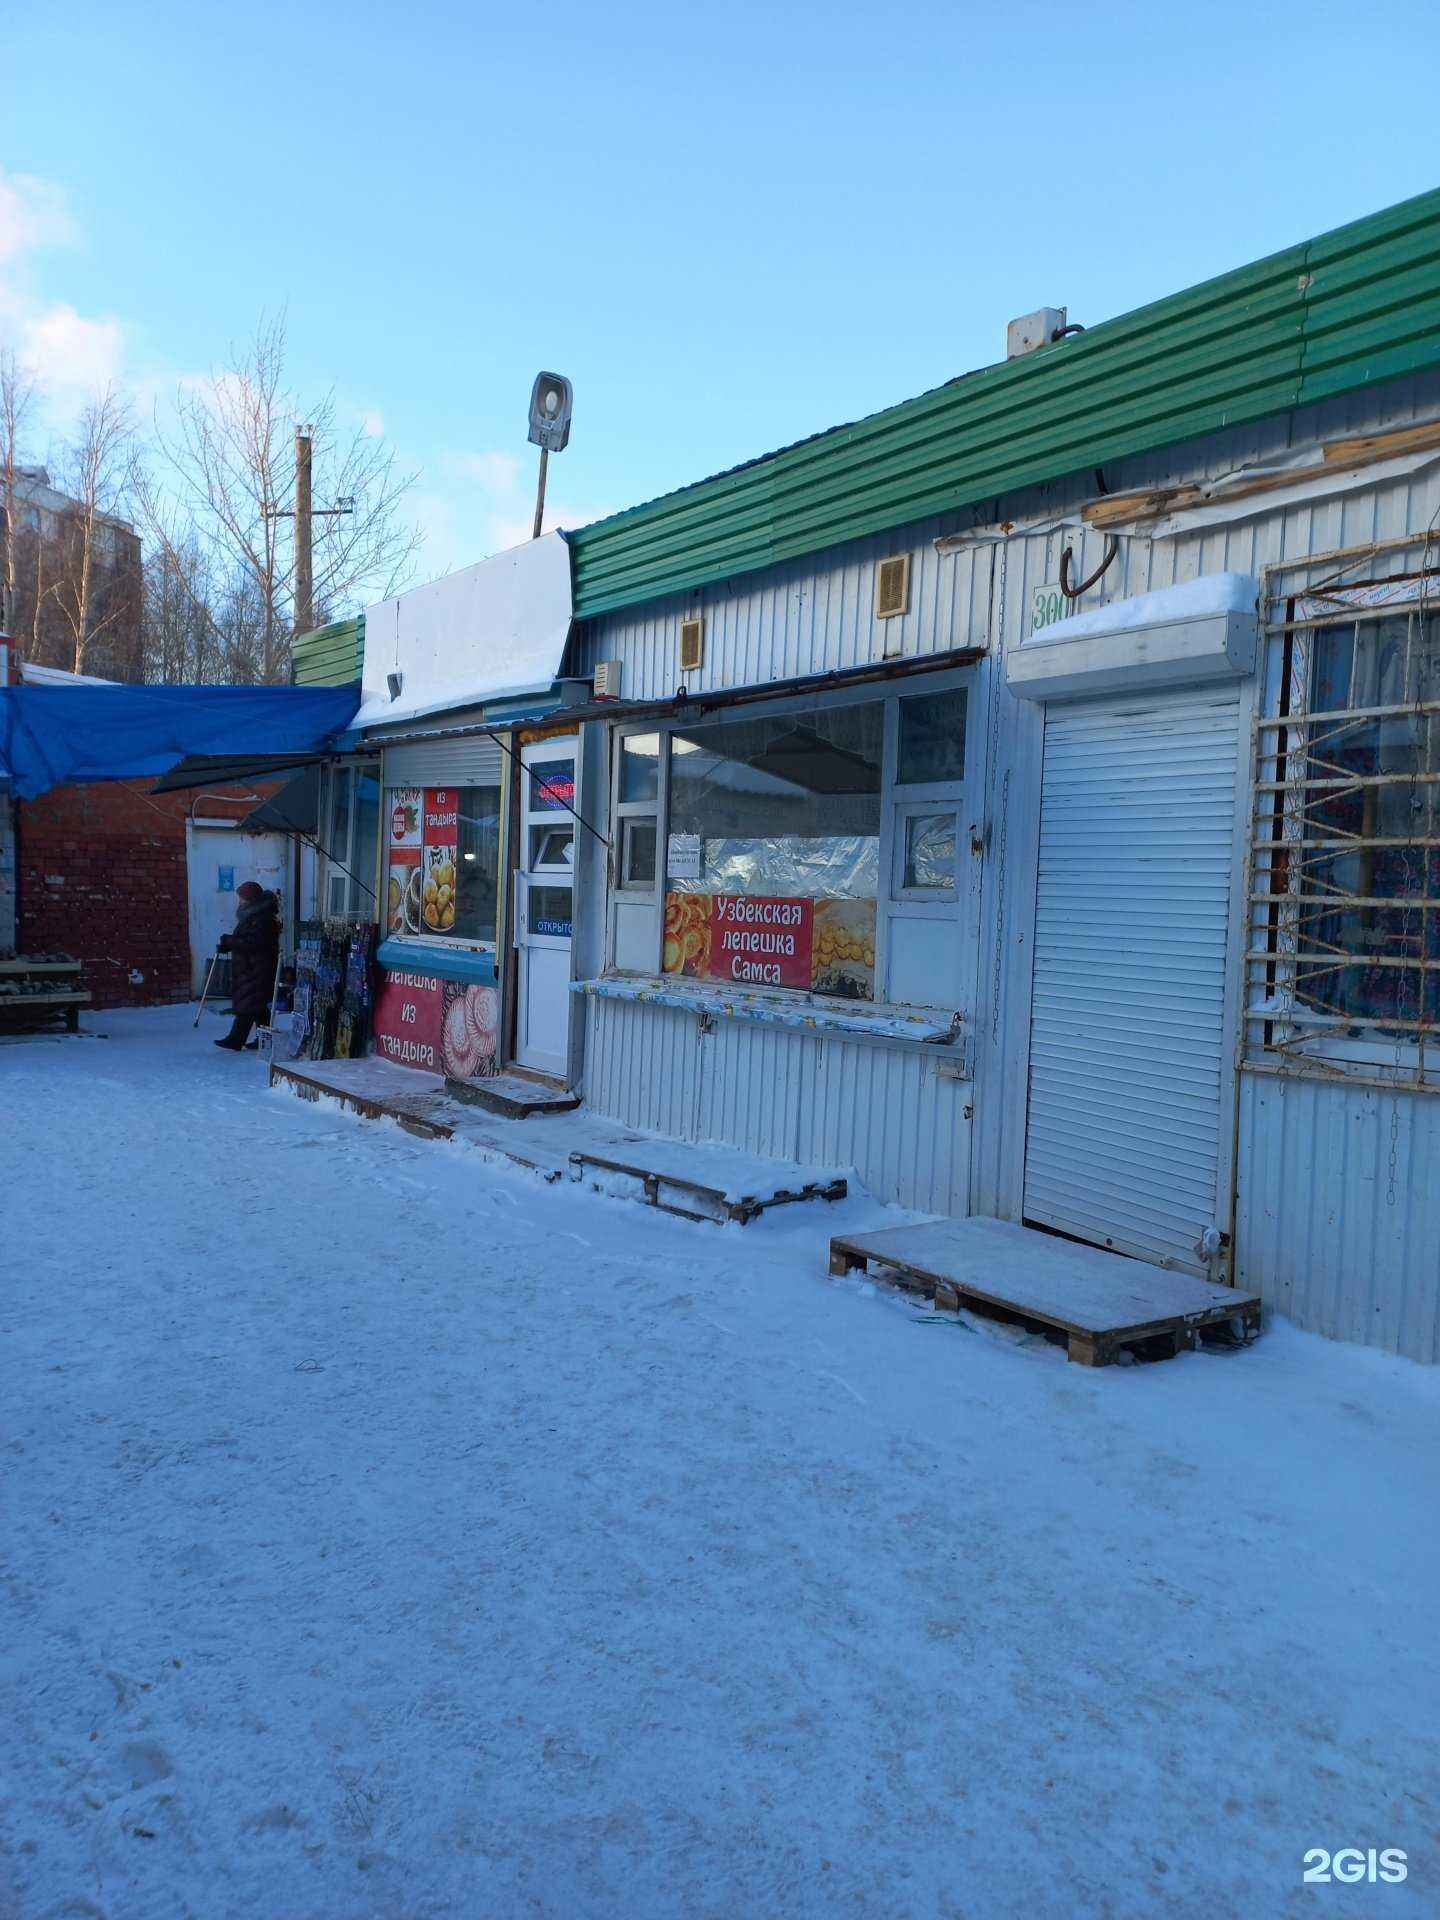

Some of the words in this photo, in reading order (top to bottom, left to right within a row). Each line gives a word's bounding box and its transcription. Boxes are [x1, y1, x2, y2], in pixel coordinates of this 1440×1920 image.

[425, 813, 457, 828] тандыра
[717, 896, 802, 925] Узбекская
[721, 930, 795, 956] лепешка
[731, 956, 781, 985] Самса
[380, 1034, 434, 1066] тандыра
